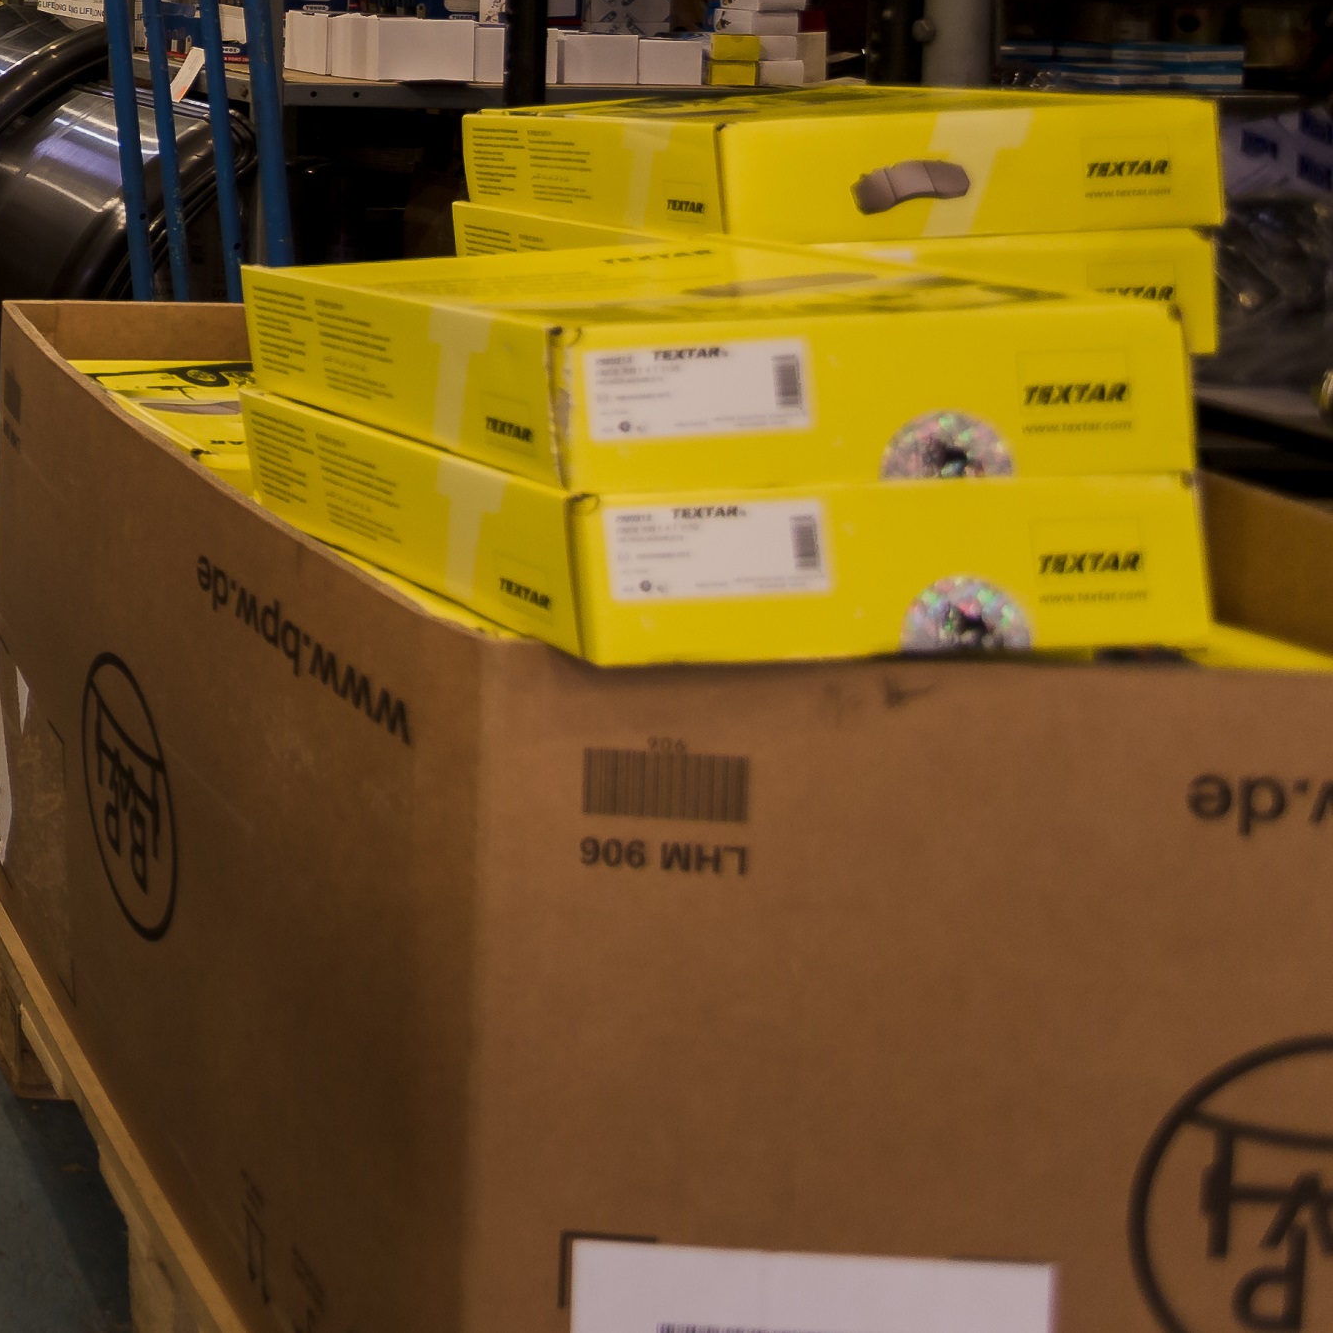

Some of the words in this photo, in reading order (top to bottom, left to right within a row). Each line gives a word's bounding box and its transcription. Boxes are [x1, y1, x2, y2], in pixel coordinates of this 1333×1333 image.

[1087, 159, 1169, 178] TEXTAR
[667, 198, 704, 214] TEXTAR
[654, 347, 721, 361] TEXTAR
[1024, 382, 1128, 405] TEXTAR
[485, 416, 534, 443] TEXTAR
[672, 506, 739, 519] TEXTAR
[1038, 550, 1141, 574] TEXTAR
[499, 577, 553, 611] TEXTAR
[197, 554, 411, 745] www.bpw.de
[580, 836, 647, 868] 906
[660, 841, 748, 875] LHM
